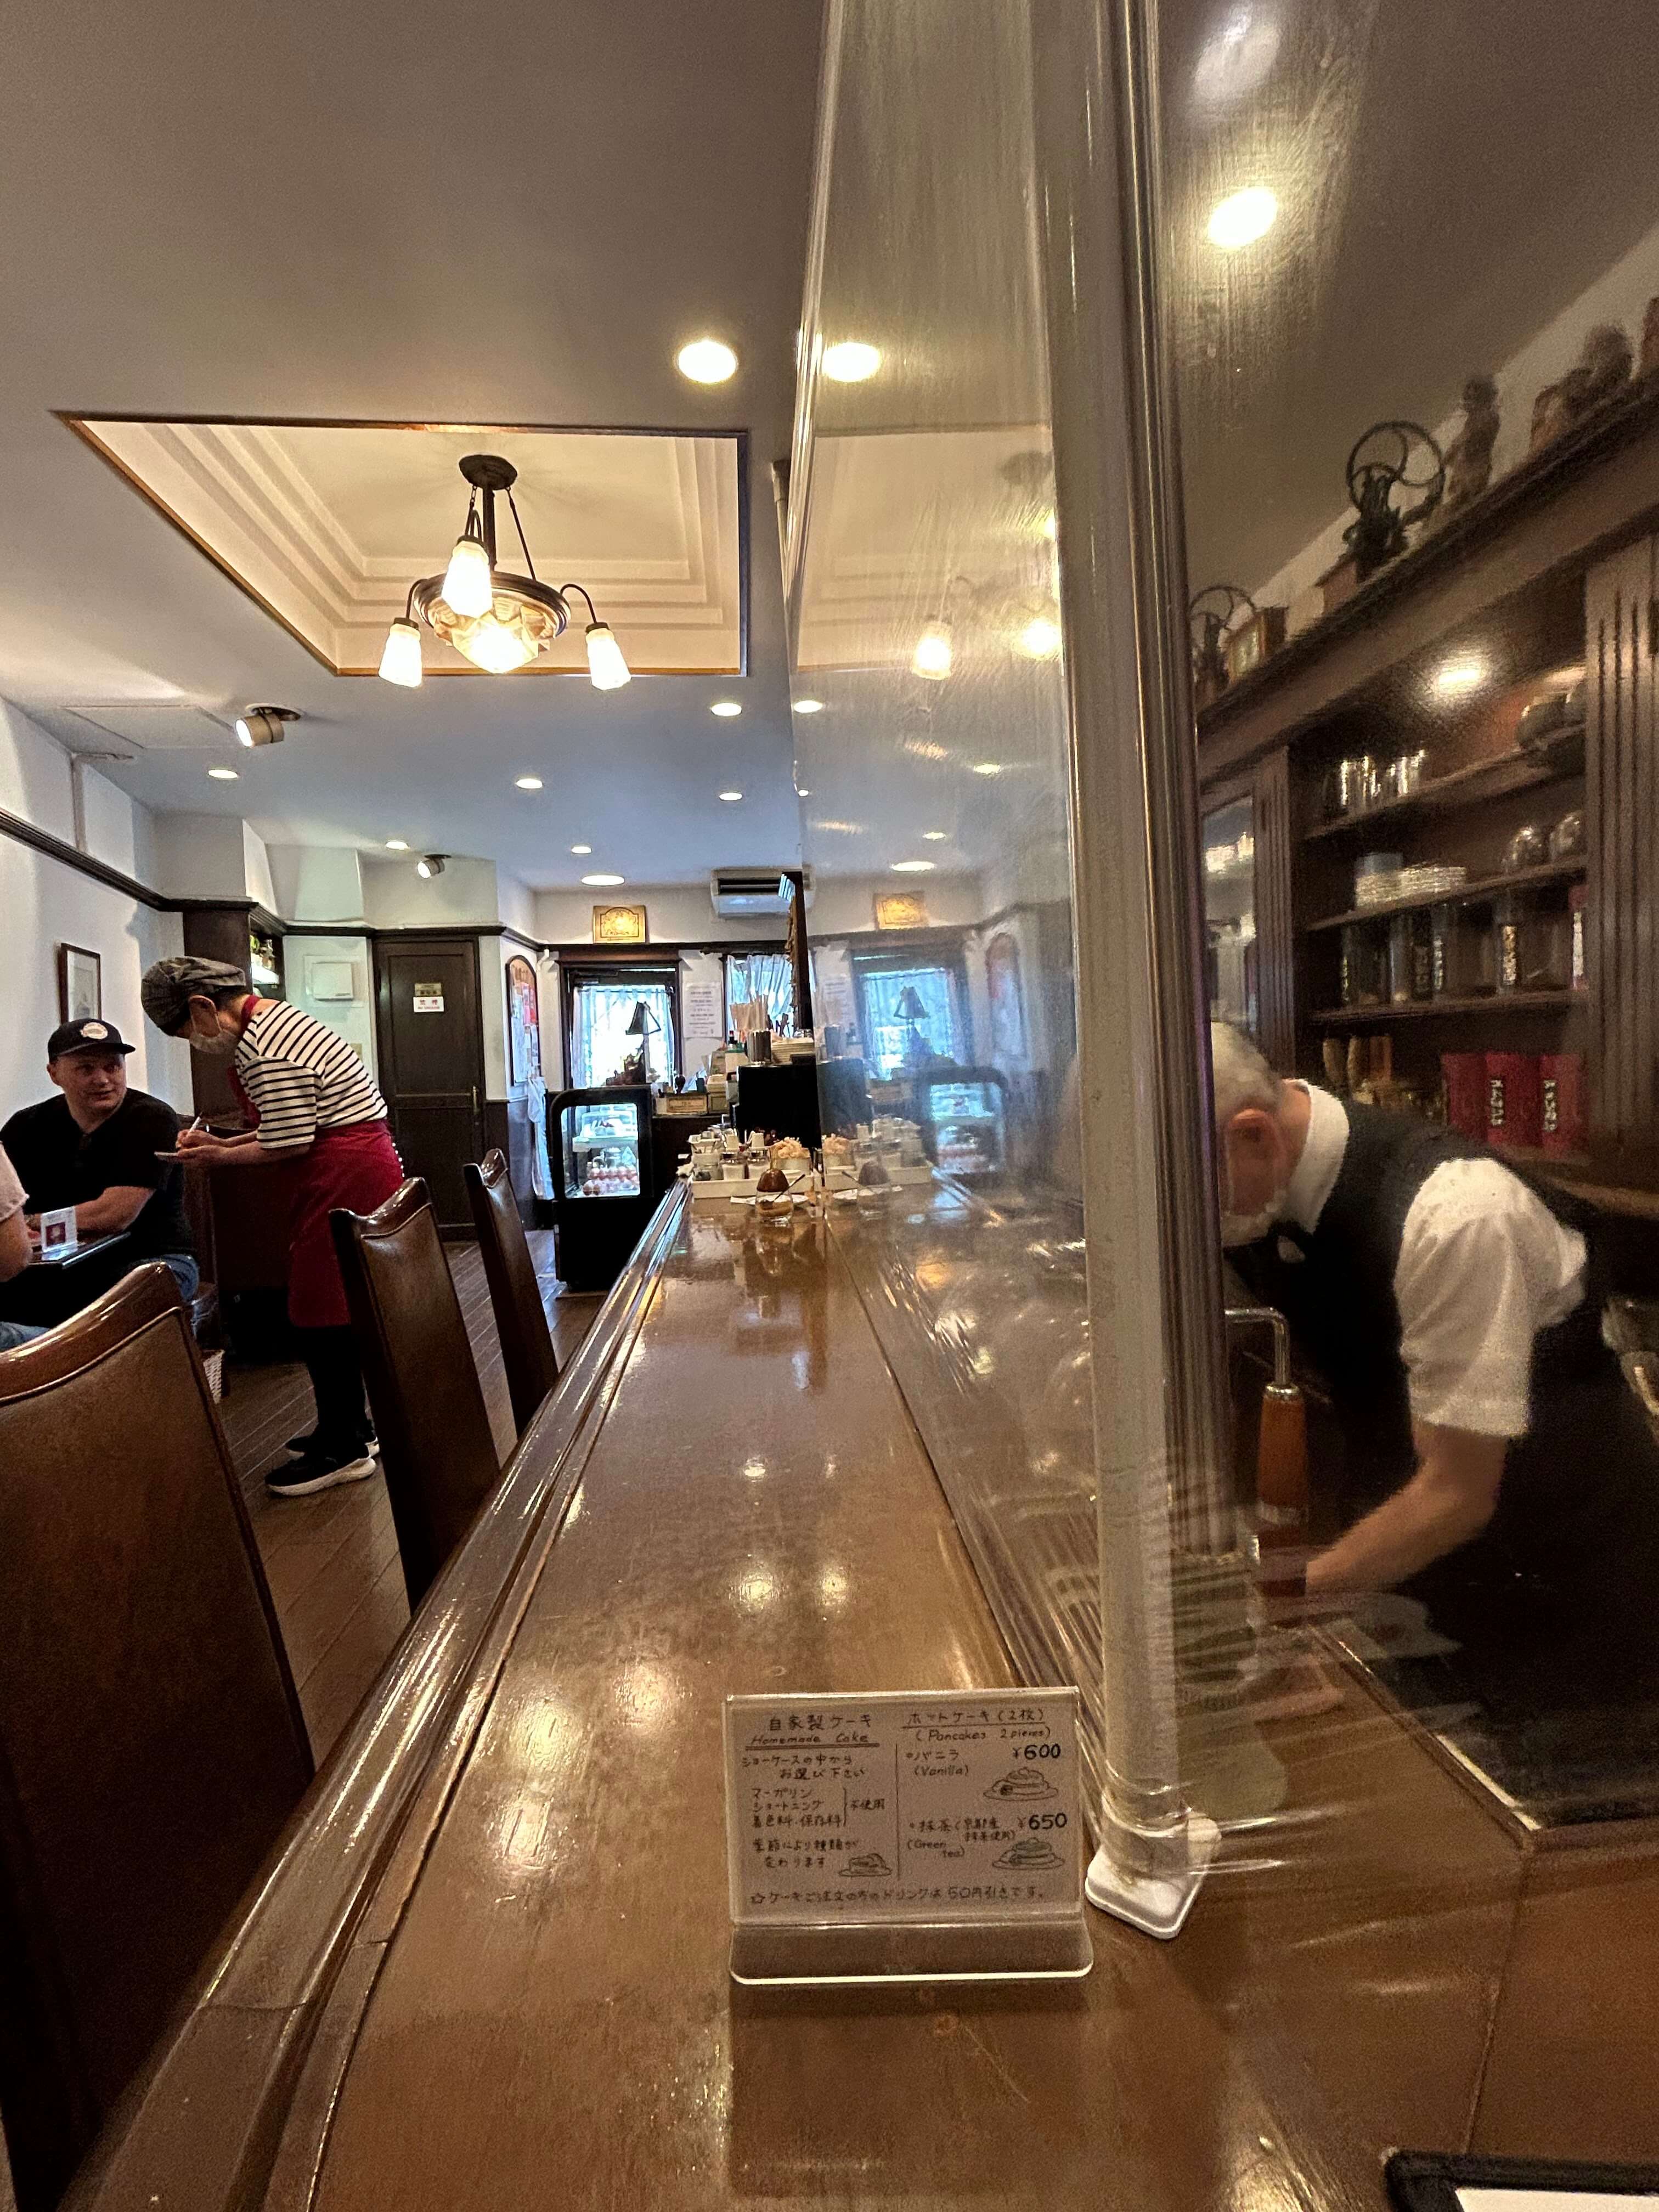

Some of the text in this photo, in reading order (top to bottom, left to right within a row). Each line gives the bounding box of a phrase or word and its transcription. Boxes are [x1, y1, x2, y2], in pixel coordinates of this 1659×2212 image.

[770, 1714, 872, 1731] 自家製ケーキ
[751, 1731, 869, 1745] Homemade Cake
[1013, 1743, 1062, 1760] ¥600
[742, 1754, 852, 1767] ショーケースの中から
[780, 1766, 865, 1780] お選び下さい
[752, 1787, 812, 1799] マーガリン
[753, 1799, 824, 1813] ショートニング
[851, 1798, 885, 1810] 不使用
[1017, 1812, 1068, 1830] ¥650
